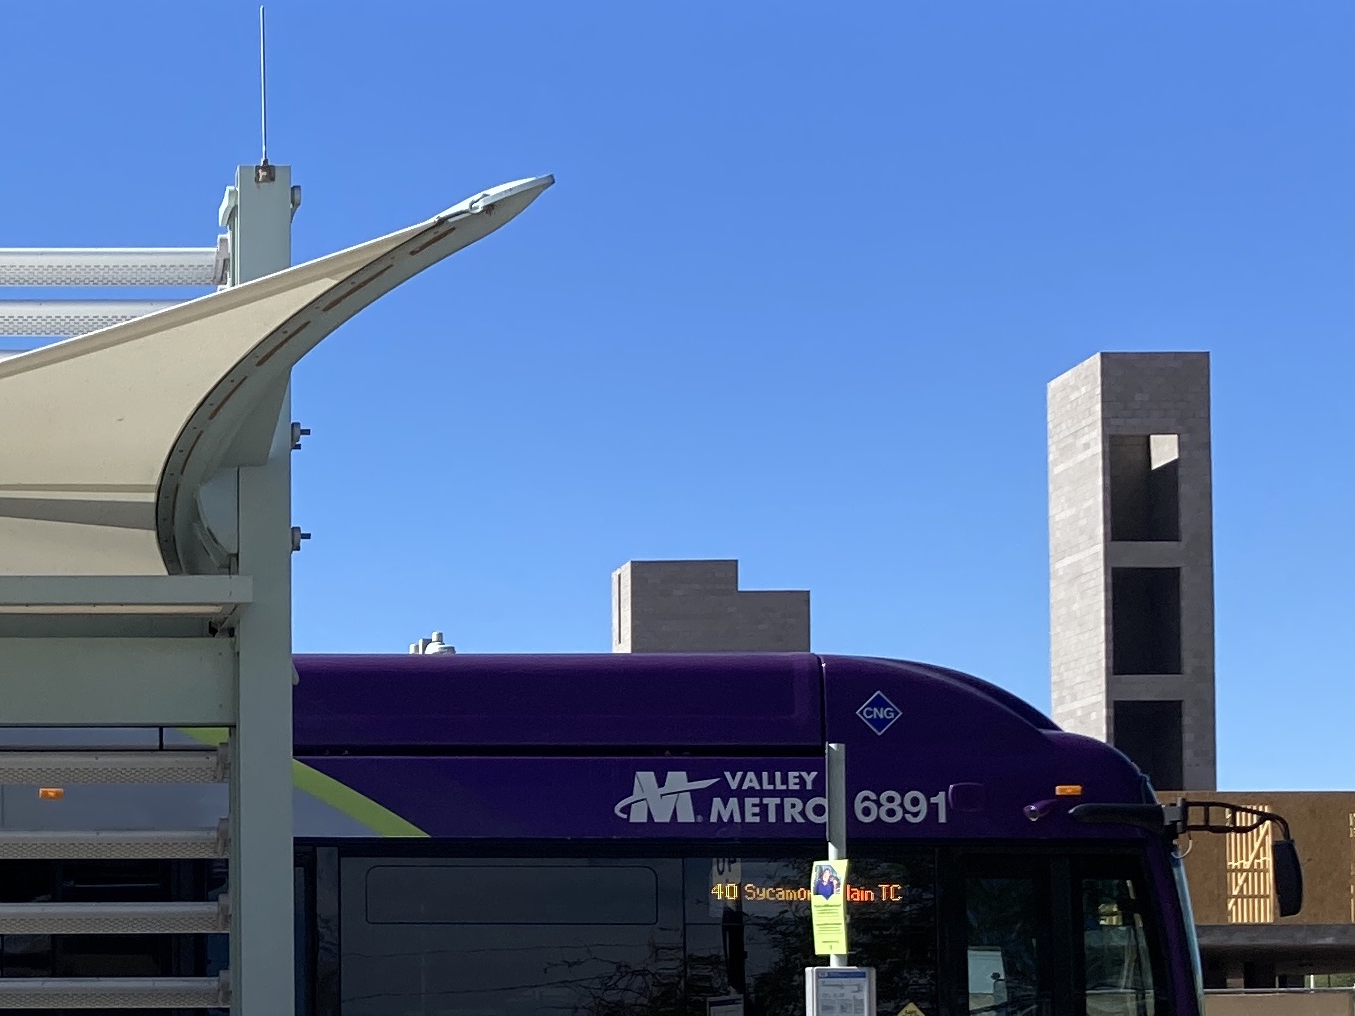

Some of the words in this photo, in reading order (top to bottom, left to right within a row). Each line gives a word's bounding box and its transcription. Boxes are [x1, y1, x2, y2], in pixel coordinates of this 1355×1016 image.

[862, 707, 895, 720] CNG
[724, 771, 818, 790] VALLEY
[709, 797, 828, 823] METRO
[854, 790, 947, 823] 6891
[711, 883, 739, 901] 40
[846, 884, 875, 901] ain
[878, 884, 903, 901] TC
